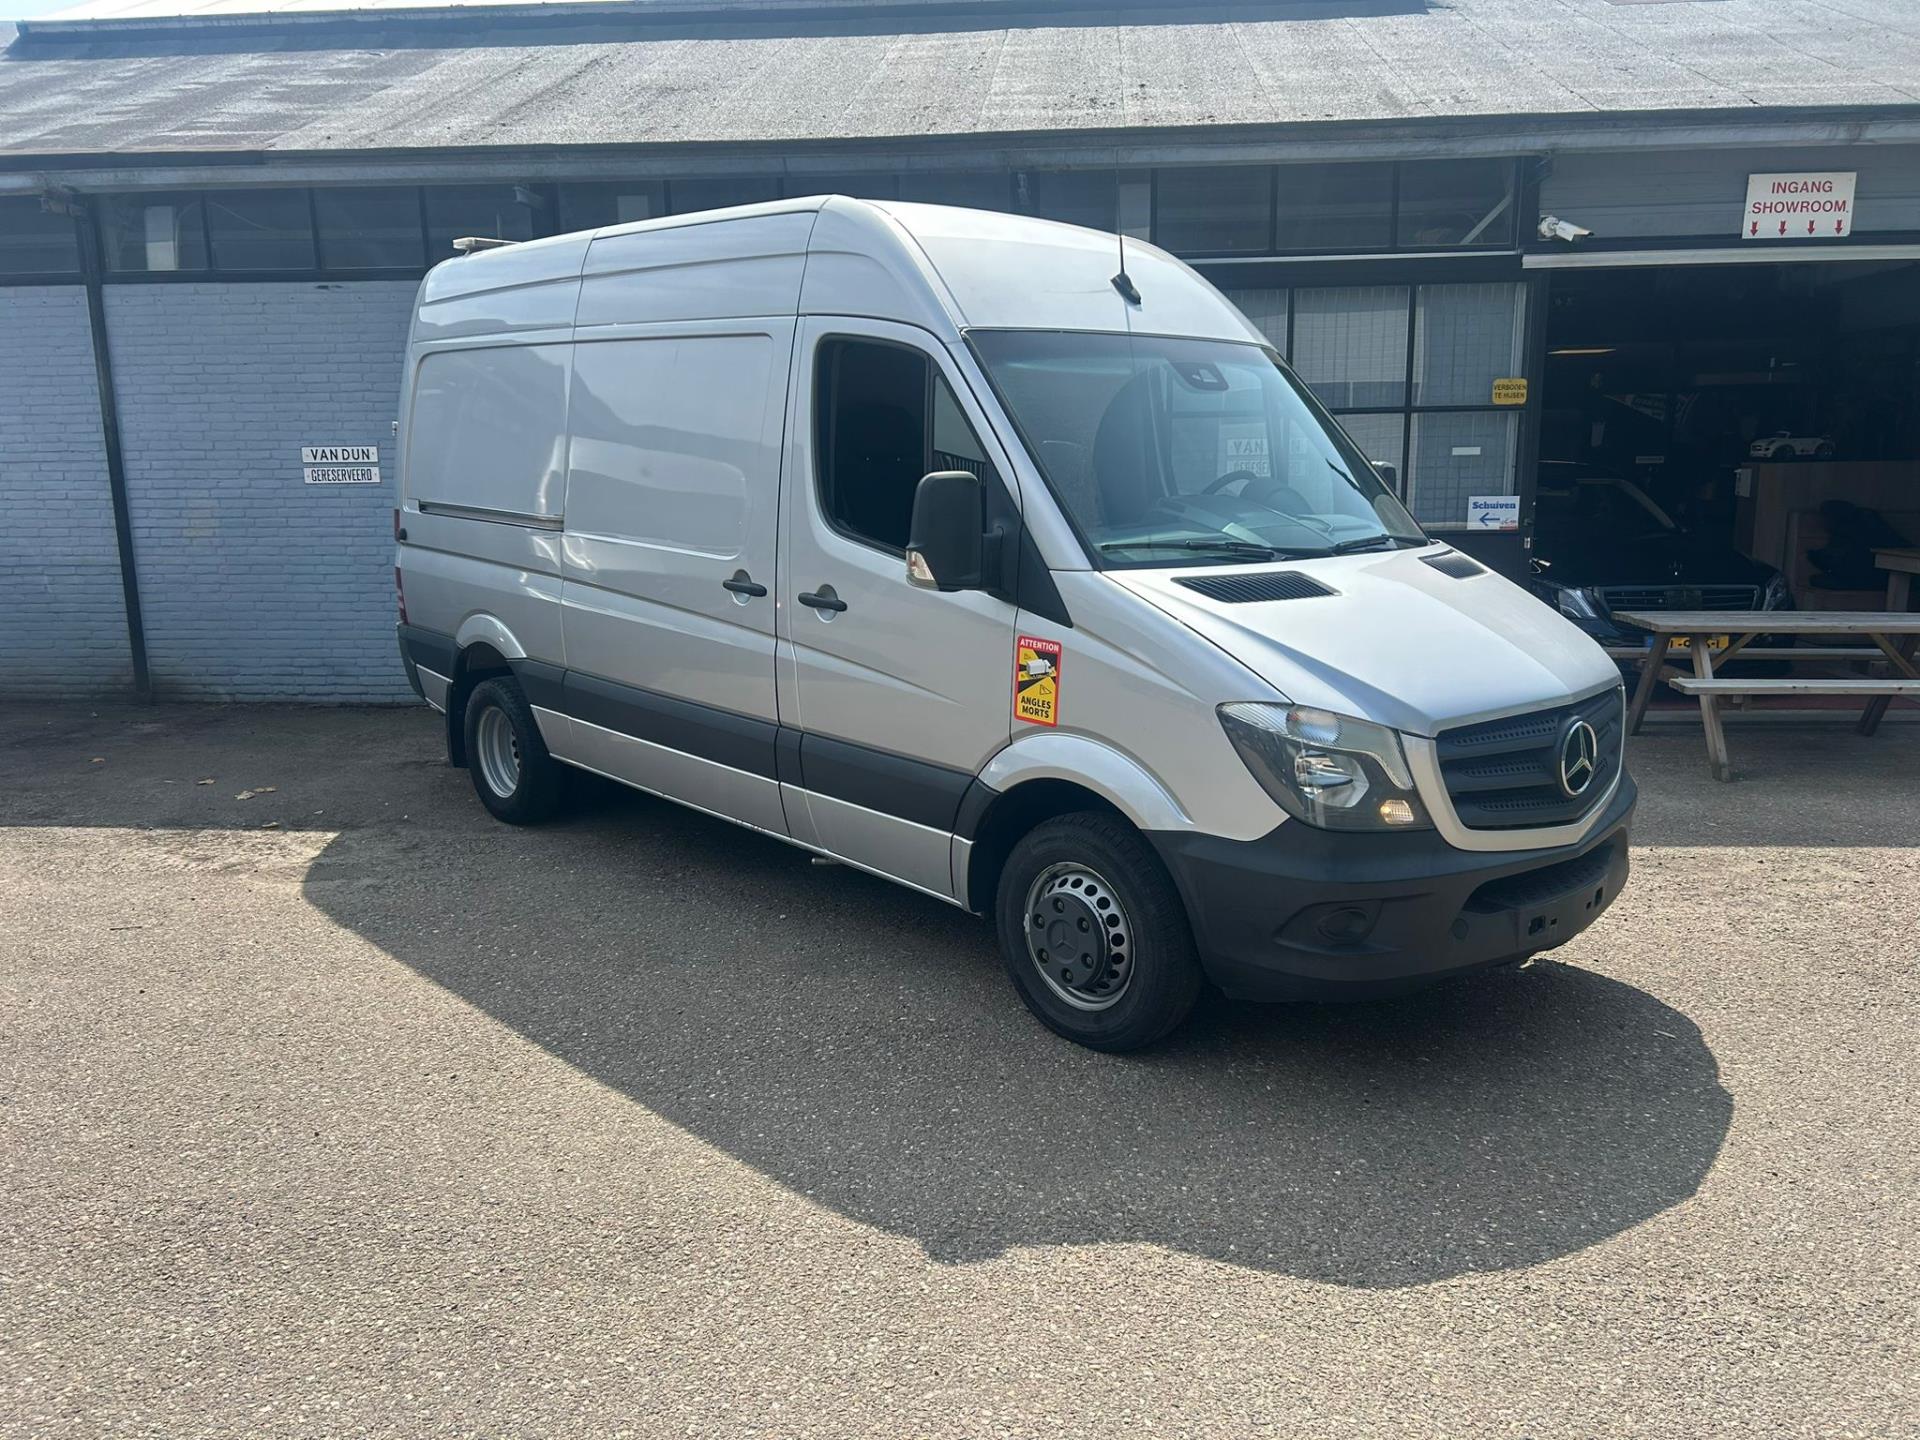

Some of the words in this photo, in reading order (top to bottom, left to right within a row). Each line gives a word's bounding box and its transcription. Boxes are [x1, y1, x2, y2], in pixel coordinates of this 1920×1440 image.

[1771, 180, 1833, 194] INGANG
[1751, 200, 1847, 214] SHOWROOM
[1494, 383, 1527, 391] VERBODEN
[1233, 440, 1264, 454] VAN
[310, 449, 338, 461] VAN
[341, 448, 371, 461] DUN
[311, 468, 372, 482] GERESERVEERD
[1472, 501, 1516, 510] Schuiven
[1020, 638, 1060, 652] ATTENTION
[1020, 696, 1051, 710] ANGLES
[1021, 705, 1050, 719] MORTS
